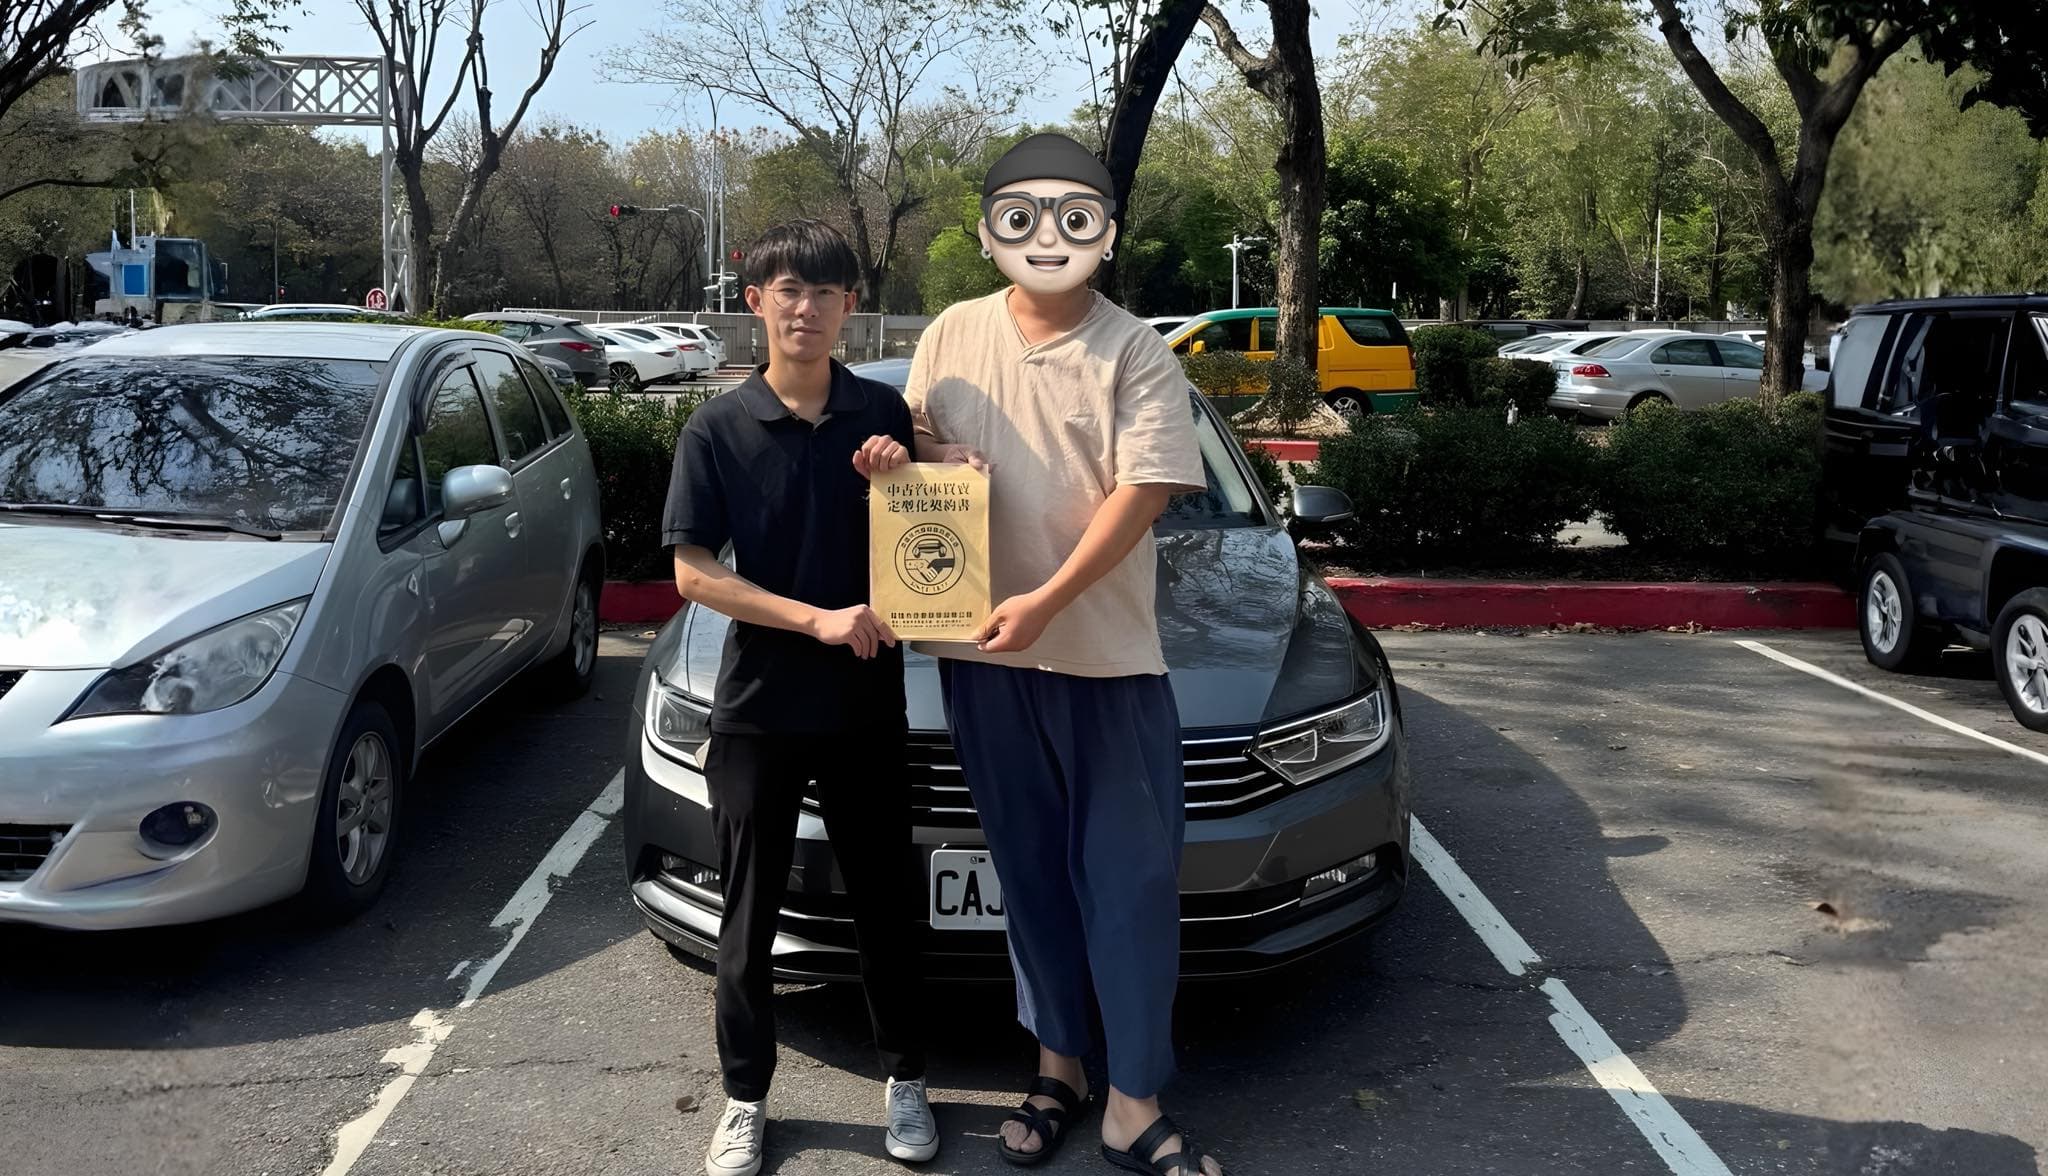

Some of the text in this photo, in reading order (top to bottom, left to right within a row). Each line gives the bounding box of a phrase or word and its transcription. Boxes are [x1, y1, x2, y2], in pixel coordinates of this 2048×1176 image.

[887, 499, 970, 513] 定型化契約書
